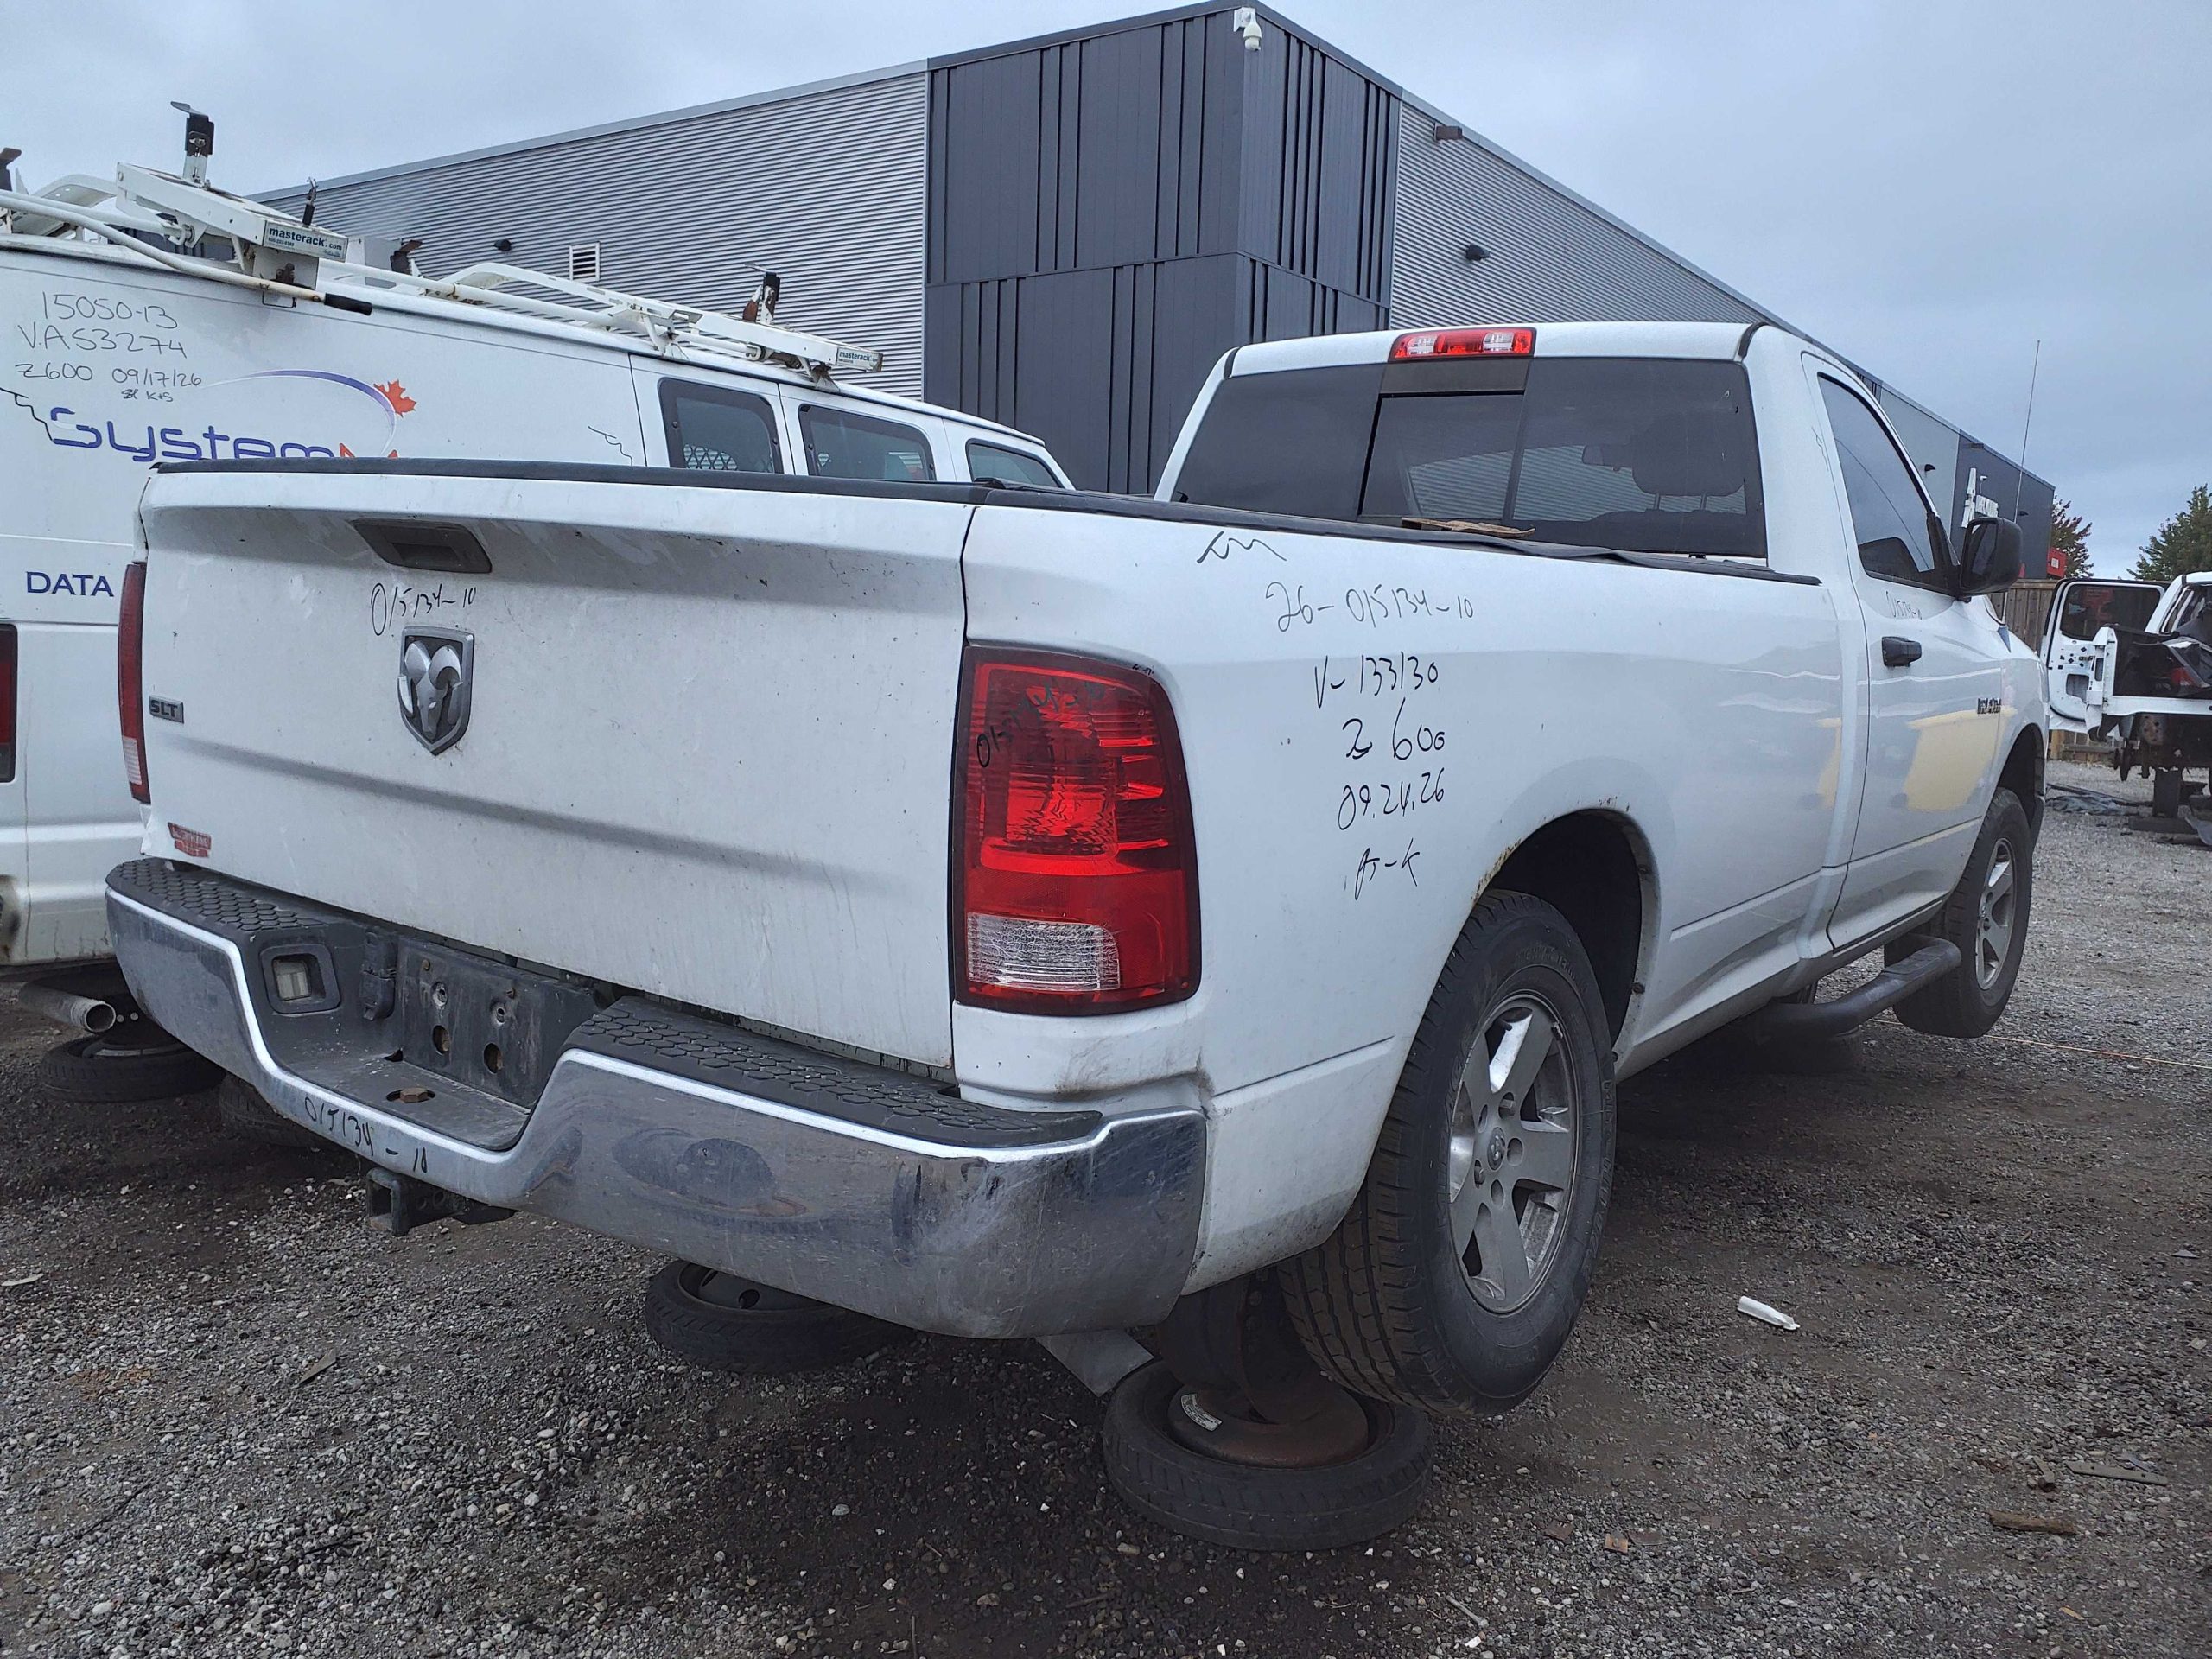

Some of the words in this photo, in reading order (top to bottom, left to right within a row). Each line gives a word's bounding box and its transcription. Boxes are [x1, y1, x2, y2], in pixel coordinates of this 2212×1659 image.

[42, 291, 178, 329] 15050-13
[111, 368, 202, 387] 09/17/26
[50, 407, 399, 461] System
[26, 571, 114, 597] DATA
[150, 699, 178, 717] SLT
